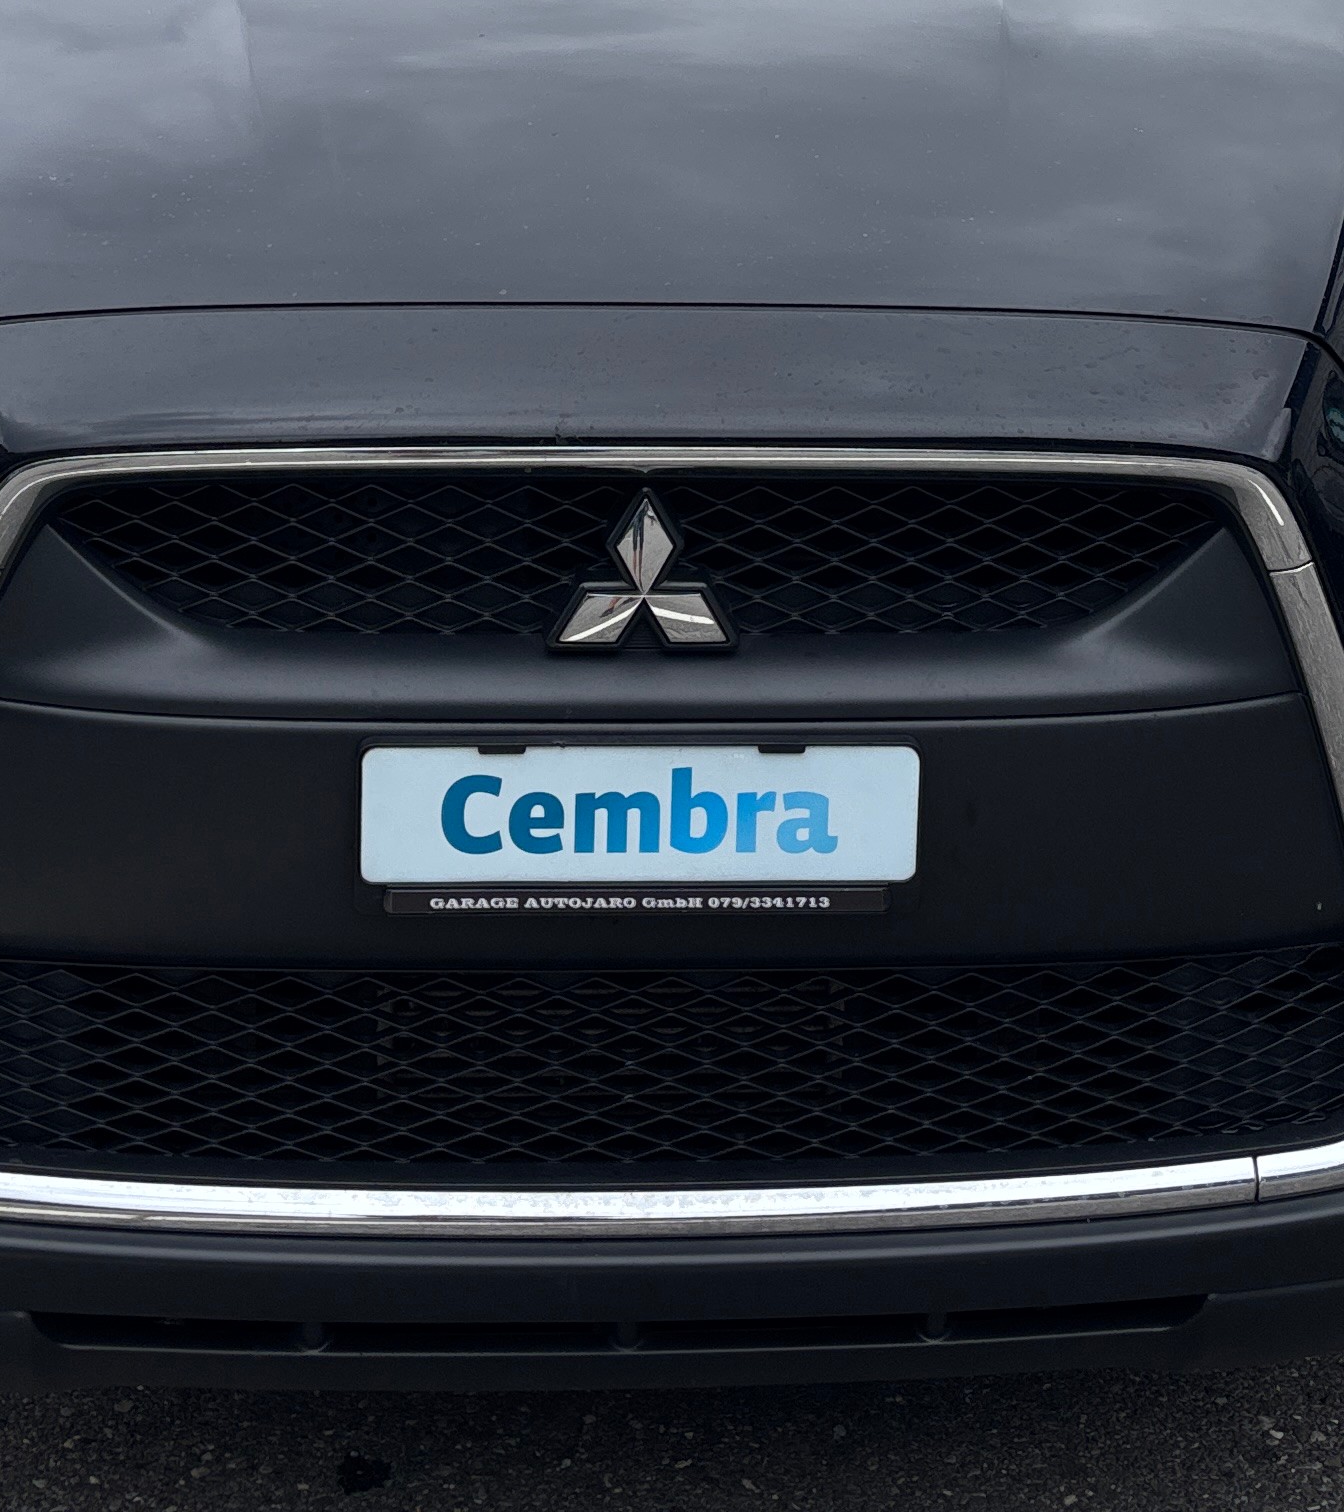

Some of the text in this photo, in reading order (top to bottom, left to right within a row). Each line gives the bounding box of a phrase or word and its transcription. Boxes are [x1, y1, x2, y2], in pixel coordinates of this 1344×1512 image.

[440, 766, 839, 856] Cembra
[429, 896, 831, 910] GARAGE AUTOJARO GmbH 079/3341713
